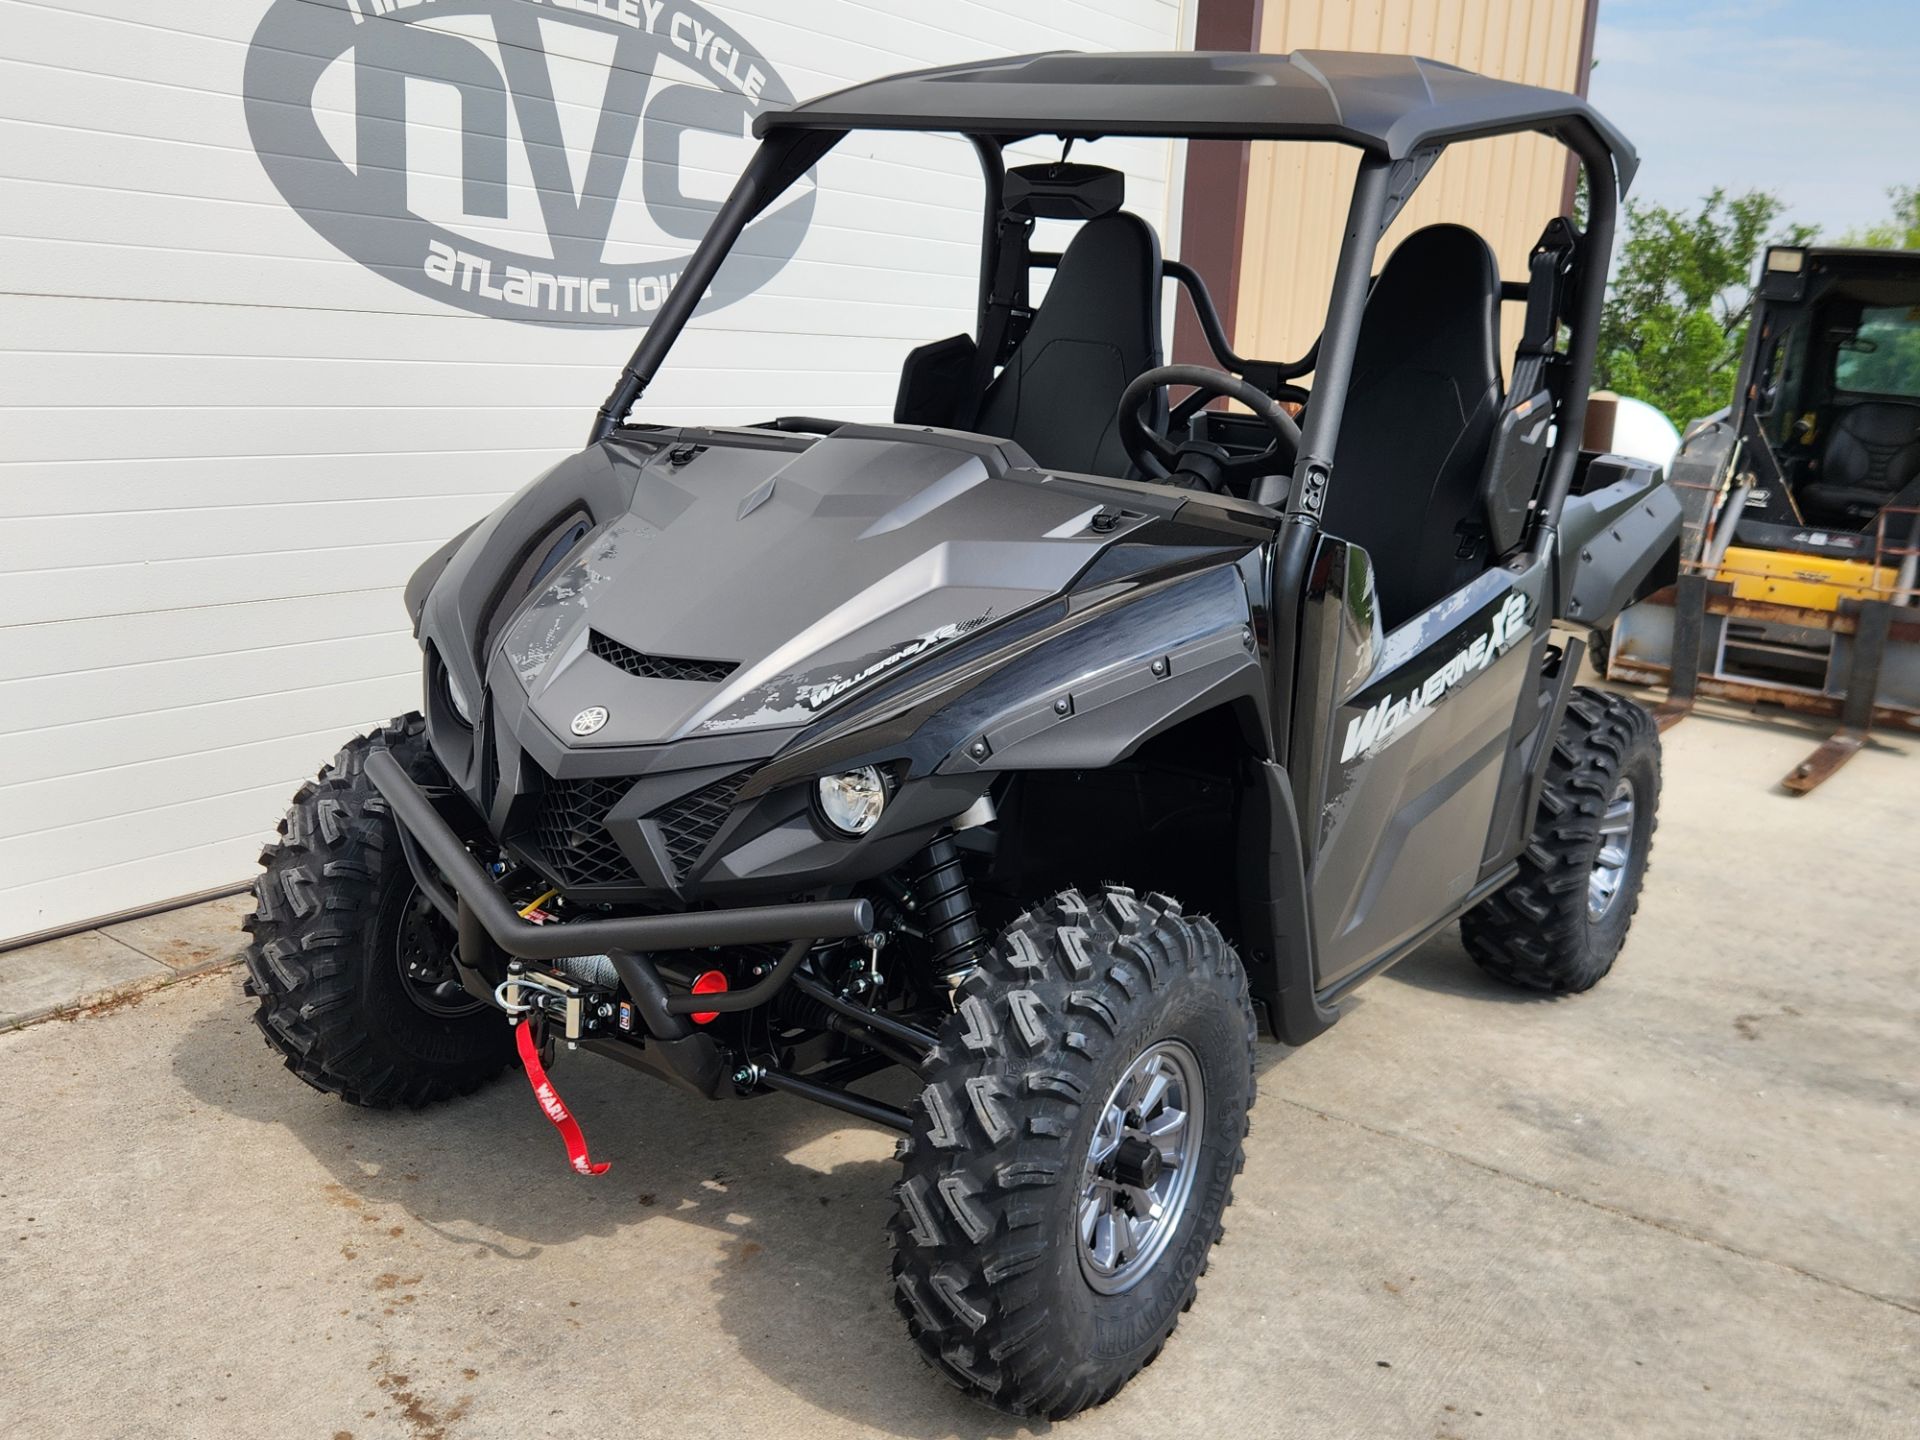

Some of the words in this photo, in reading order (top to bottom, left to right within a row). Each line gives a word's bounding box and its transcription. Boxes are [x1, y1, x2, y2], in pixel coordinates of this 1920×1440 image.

[670, 11, 766, 107] CYCLE
[628, 271, 712, 313] IOW
[810, 643, 920, 707] WOLVERINE
[1340, 632, 1488, 764] WOLVERINE
[1478, 593, 1527, 670] X2
[537, 1082, 568, 1123] WARN
